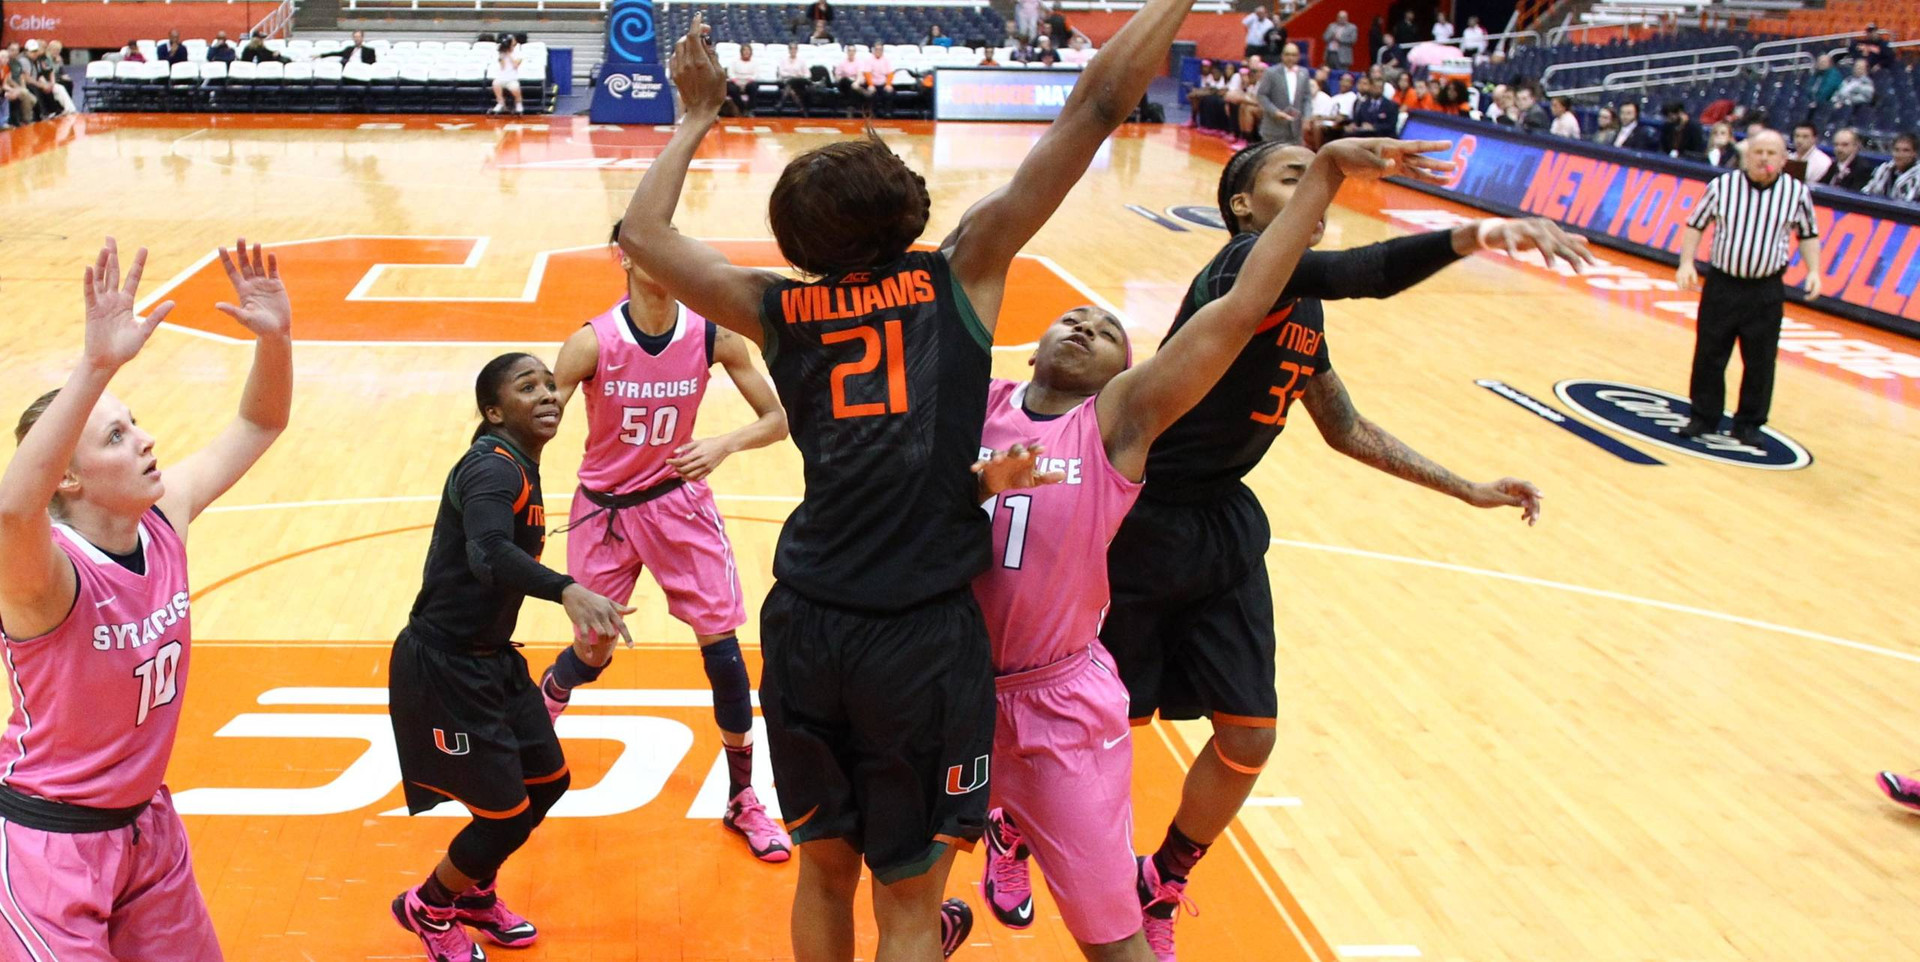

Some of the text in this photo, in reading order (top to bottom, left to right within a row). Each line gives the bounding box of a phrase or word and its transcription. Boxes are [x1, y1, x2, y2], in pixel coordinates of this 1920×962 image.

[9, 14, 56, 30] Cable
[1519, 149, 1621, 228] NEW
[1598, 165, 1717, 262] YOR
[781, 269, 936, 325] WILLIAMS
[839, 271, 872, 284] ACC
[603, 377, 698, 399] SYRACUSE
[820, 320, 909, 420] 21
[618, 404, 680, 447] 50
[92, 587, 190, 651] SYRACUS
[132, 638, 183, 728] 10
[432, 727, 470, 756] U
[945, 753, 989, 796] U
